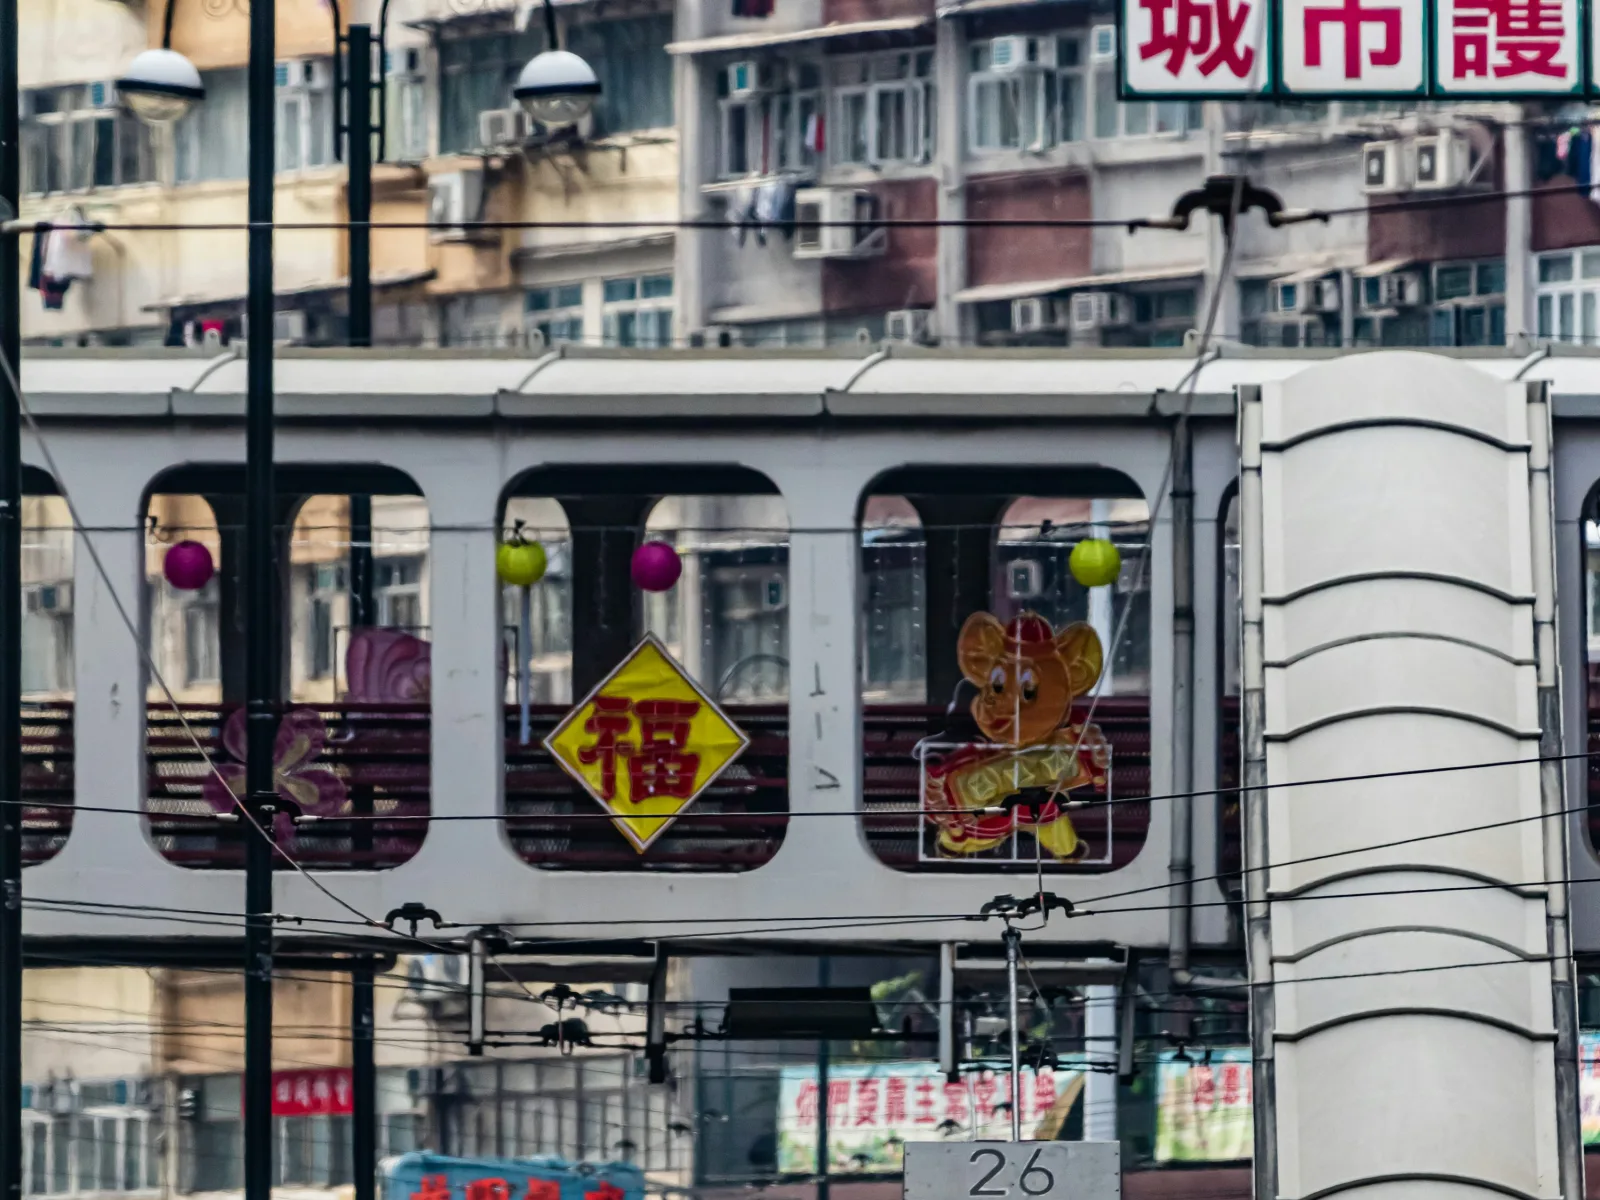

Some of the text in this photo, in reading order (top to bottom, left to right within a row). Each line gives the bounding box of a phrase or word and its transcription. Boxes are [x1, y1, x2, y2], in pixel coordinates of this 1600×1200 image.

[1138, 0, 1568, 79] 城市護
[576, 695, 700, 804] 福
[970, 1147, 1055, 1197] 26
